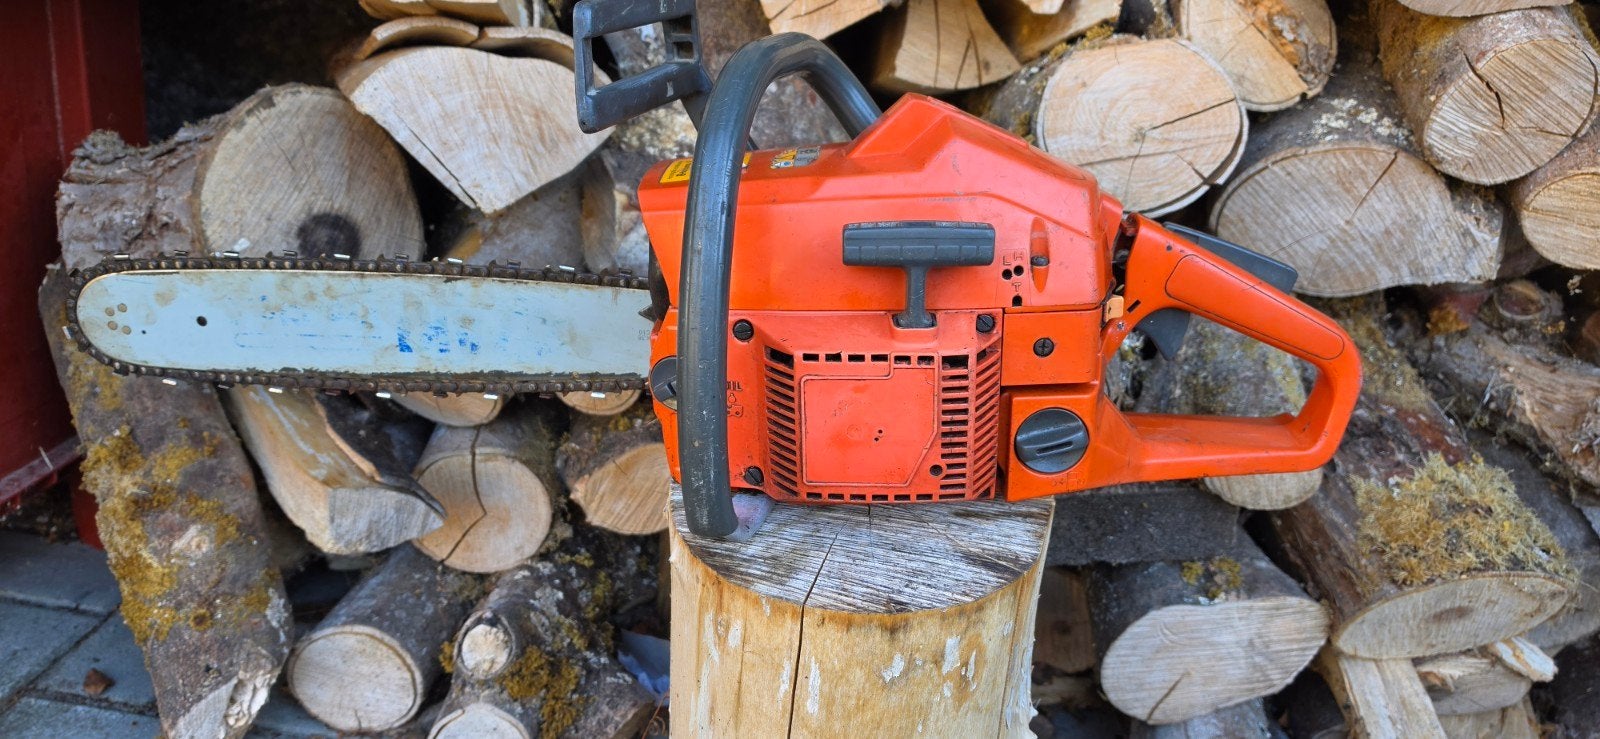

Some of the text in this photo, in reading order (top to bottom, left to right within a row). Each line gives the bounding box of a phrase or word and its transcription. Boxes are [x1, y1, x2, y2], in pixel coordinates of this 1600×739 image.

[1002, 251, 1023, 266] L H
[1011, 282, 1022, 293] T
